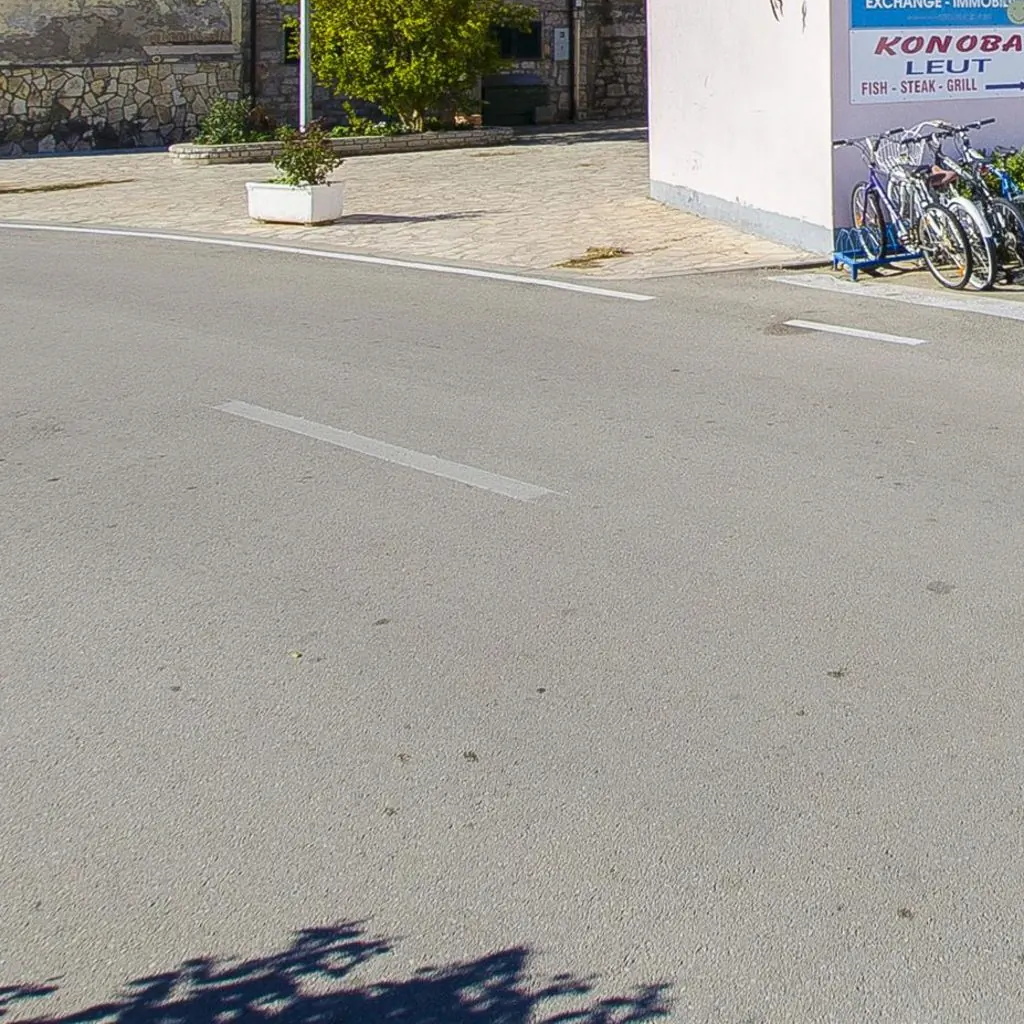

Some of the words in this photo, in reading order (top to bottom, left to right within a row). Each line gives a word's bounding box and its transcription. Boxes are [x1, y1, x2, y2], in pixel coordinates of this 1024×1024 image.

[874, 34, 1023, 56] KONOBA
[906, 58, 992, 75] LEUT
[861, 81, 888, 95] FISH
[900, 79, 936, 93] STEAK
[947, 78, 978, 92] GRILL
